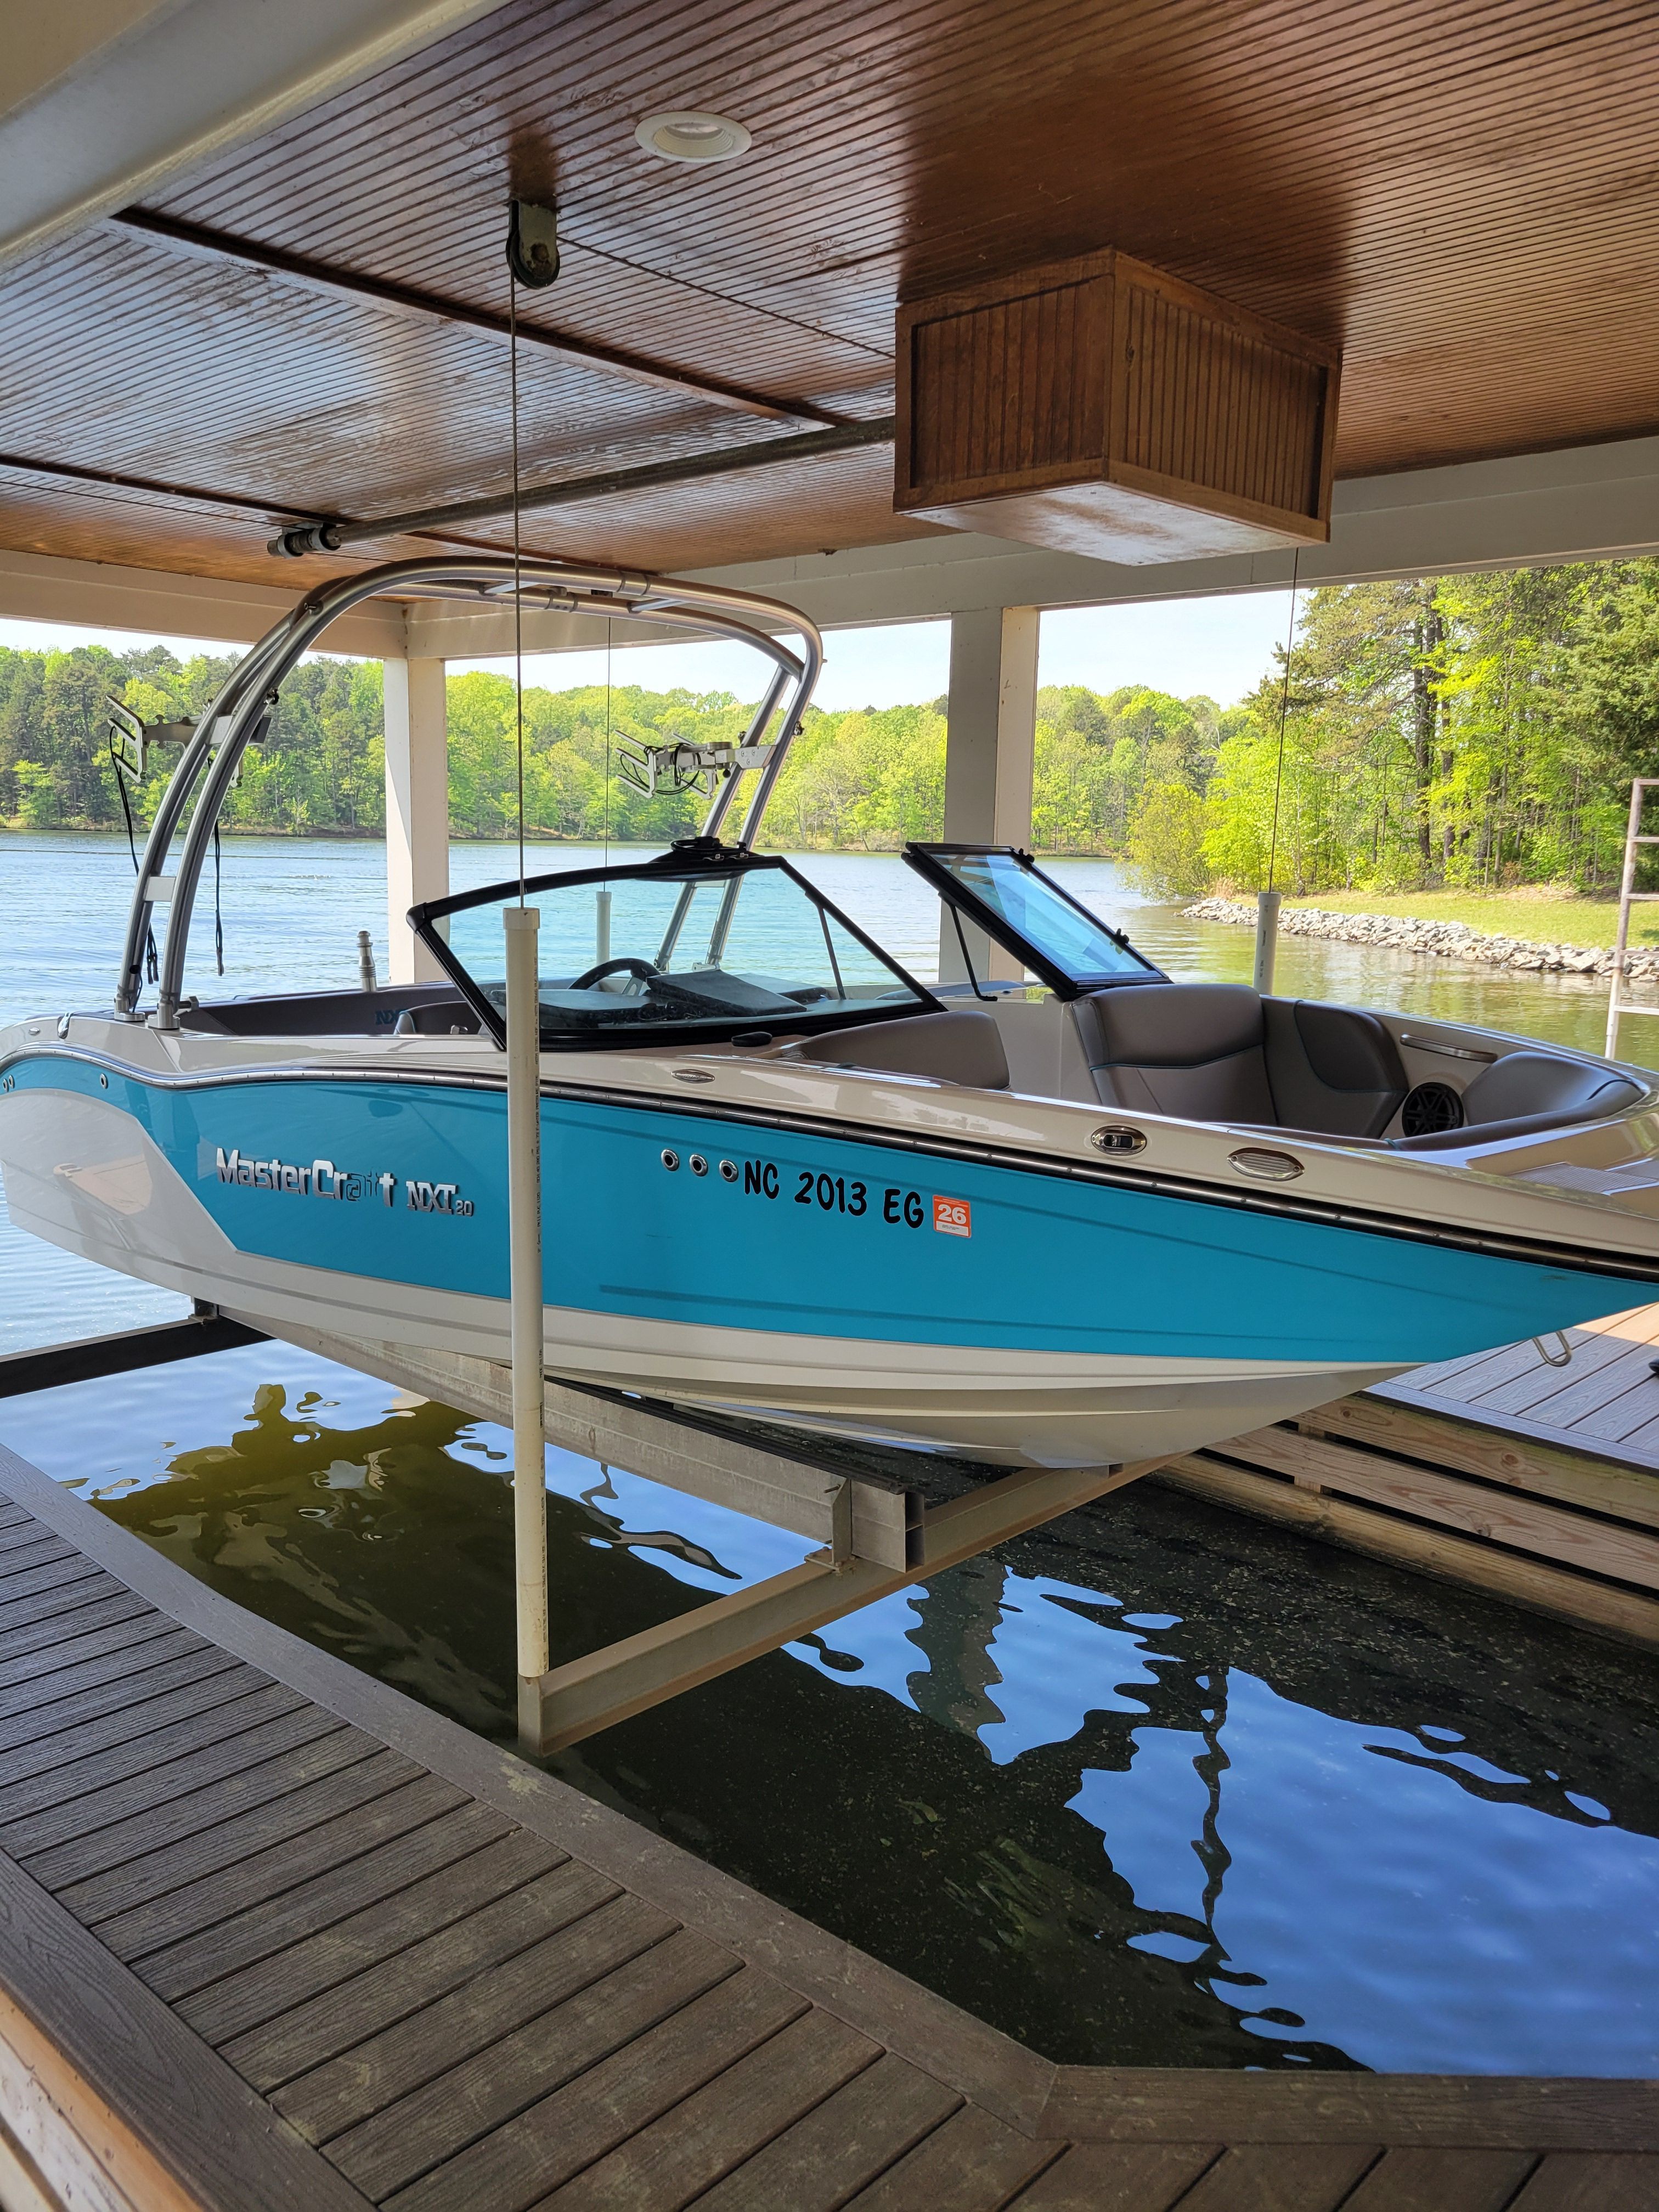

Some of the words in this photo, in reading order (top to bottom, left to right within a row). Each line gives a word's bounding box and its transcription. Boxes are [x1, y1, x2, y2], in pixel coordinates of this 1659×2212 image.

[406, 1181, 458, 1215] NXT
[455, 1200, 473, 1216] 20
[744, 1159, 780, 1199] NC
[794, 1171, 867, 1216] 2013
[883, 1188, 924, 1228] EG
[938, 1204, 967, 1224] 26
